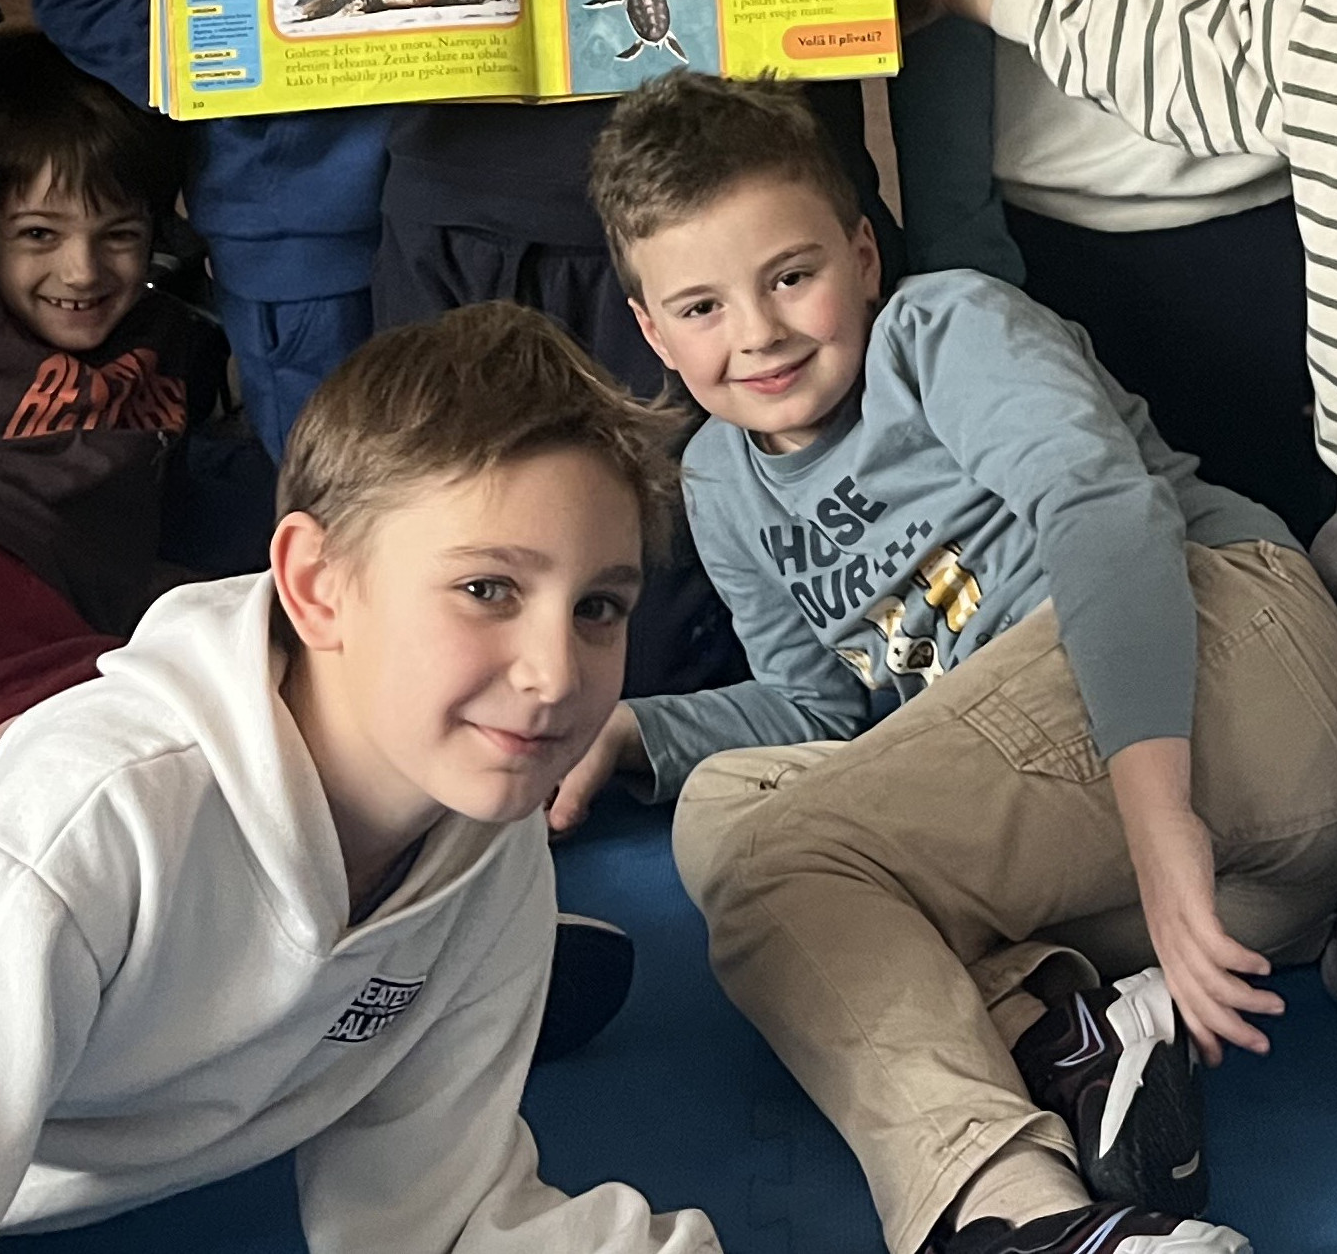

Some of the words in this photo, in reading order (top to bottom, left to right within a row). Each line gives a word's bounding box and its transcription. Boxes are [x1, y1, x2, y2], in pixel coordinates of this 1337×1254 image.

[734, 10, 766, 24] poput
[798, 34, 826, 45] Voliš
[829, 34, 837, 44] li
[839, 31, 882, 46] plivati?
[285, 47, 330, 59] Goleme
[461, 52, 475, 60] na
[286, 75, 314, 86] kako
[316, 73, 328, 85] bi
[378, 70, 398, 83] jaja
[401, 70, 415, 78] na
